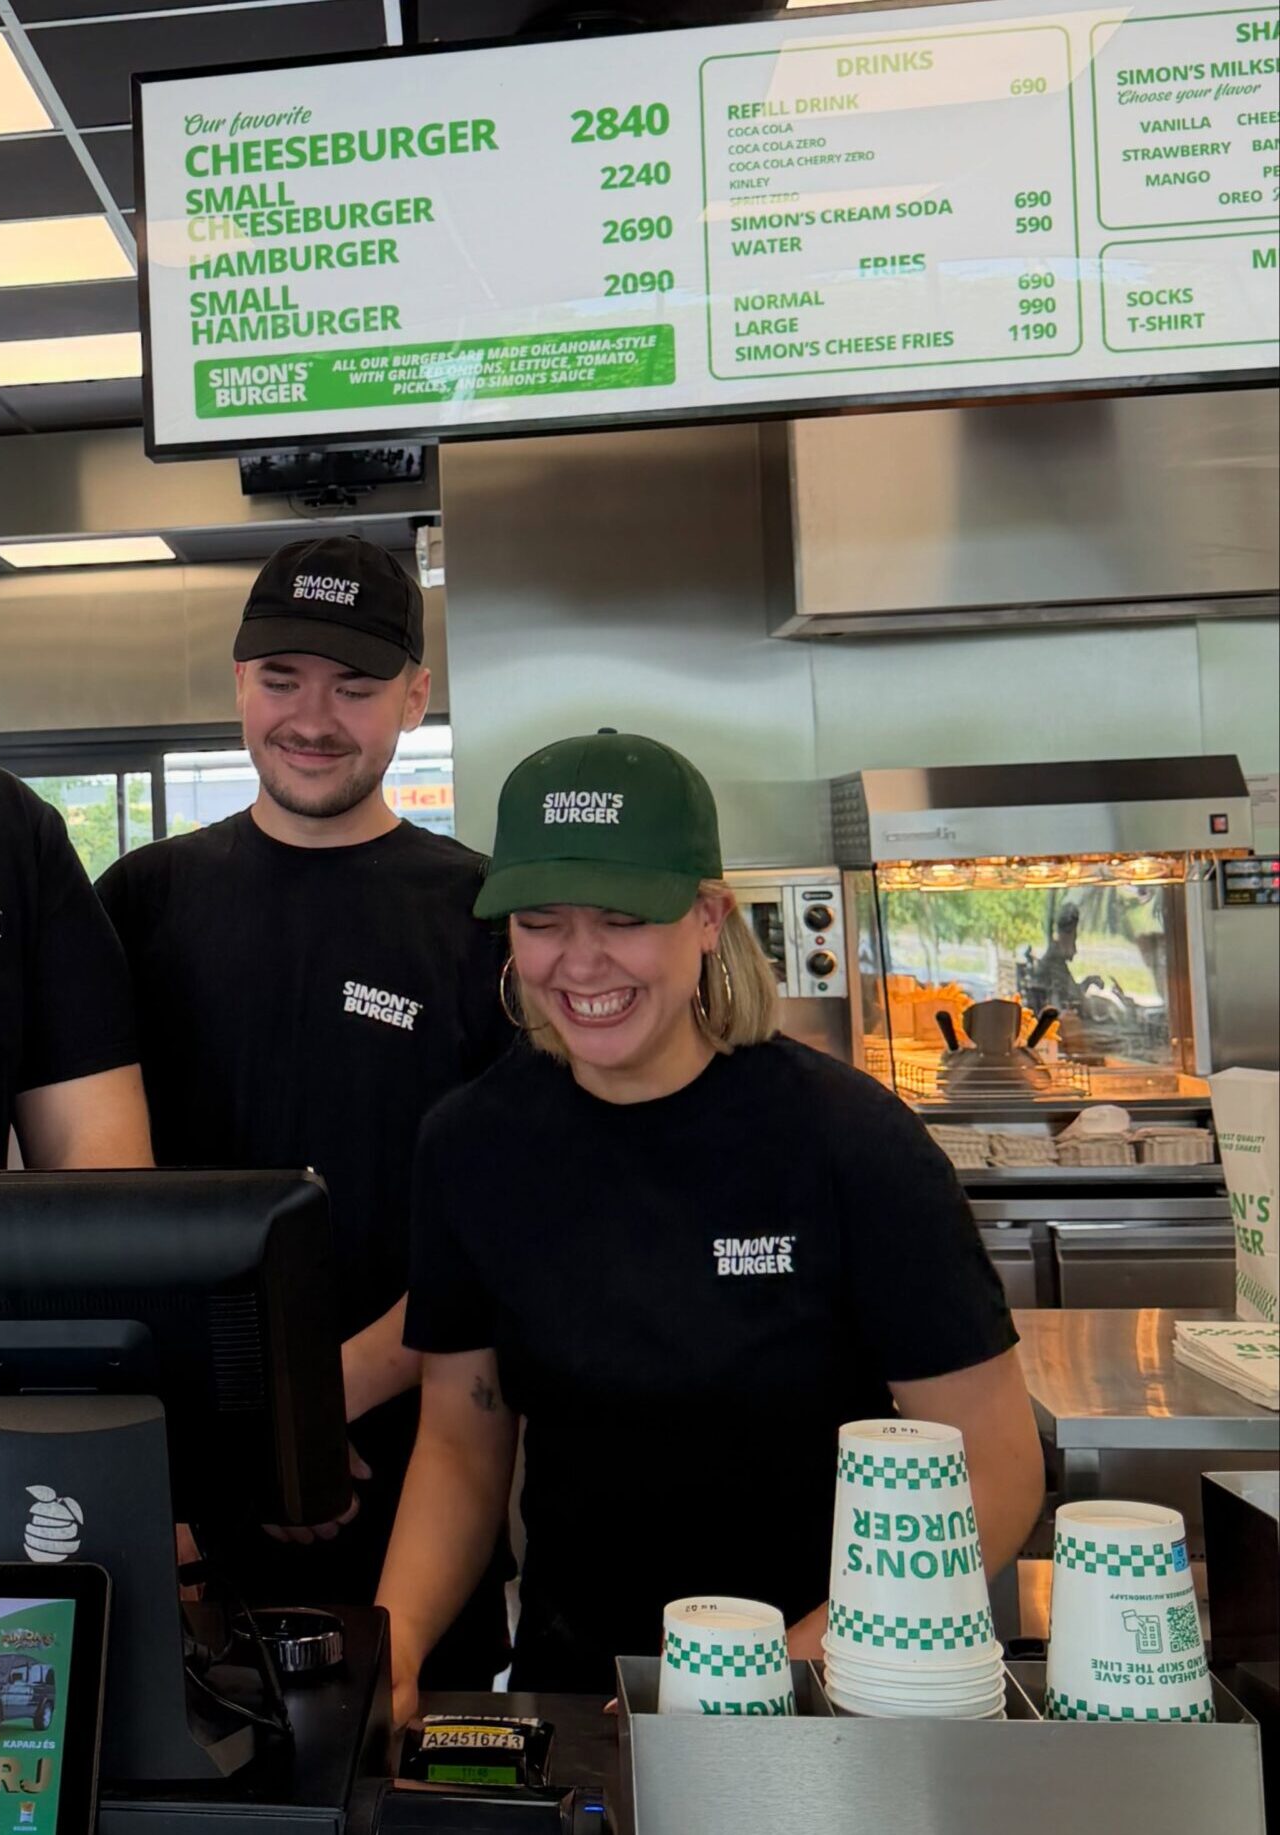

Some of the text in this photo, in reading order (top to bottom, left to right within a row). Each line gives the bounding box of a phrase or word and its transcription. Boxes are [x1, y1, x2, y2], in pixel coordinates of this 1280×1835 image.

[836, 50, 934, 78] DRINKS
[1116, 57, 1280, 86] SIMON'S MILKS
[1010, 77, 1046, 95] 690
[1117, 83, 1262, 105] Choose your flavor
[728, 94, 860, 120] REFILL DRINK
[184, 106, 312, 137] Our favorite
[571, 102, 670, 144] 2840
[1140, 116, 1212, 134] VANILLA
[1237, 110, 1280, 126] CHEE
[728, 123, 794, 138] COCA COLA
[185, 119, 499, 177] CHEESEBURGER
[728, 137, 827, 156] COCA COLA ZERO
[1122, 141, 1232, 162] STRAWBERRY
[729, 150, 875, 173] COCA COLA CHERRY ZERO
[601, 161, 671, 189] 2240
[729, 177, 770, 190] KINLEY
[1145, 170, 1210, 187] MANGO
[186, 182, 295, 215] SMALL
[1014, 190, 1051, 209] 690
[1218, 190, 1263, 205] OREO
[187, 197, 435, 242] CHEESEBURGER
[731, 199, 953, 232] SIMON'S CREAM SODA
[1015, 215, 1052, 234] 590
[602, 215, 673, 244] 2690
[732, 237, 802, 257] WATER
[189, 238, 400, 280] HAMBURGER
[859, 253, 926, 277] FRIES
[604, 269, 674, 297] 2090
[1018, 272, 1055, 290] 690
[190, 285, 299, 318] SMALL
[734, 290, 825, 312] NORMAL
[1019, 297, 1056, 315] 990
[1127, 288, 1194, 308] SOCKS
[191, 305, 402, 346] HAMBURGER
[735, 317, 799, 337] LARGE
[1008, 322, 1057, 341] 1190
[1127, 312, 1205, 333] T-SHIRT
[332, 359, 357, 372] ALL
[360, 357, 389, 370] OUR
[392, 351, 456, 367] BURGERS
[487, 345, 528, 360] MADE
[531, 335, 657, 357] OKLAHOMA-STYLE
[735, 331, 954, 362] SIMON'S CHEESE FRIES
[209, 362, 309, 388] SIMON'S
[349, 371, 384, 385] WITH
[510, 355, 571, 372] LETTUCE,
[393, 368, 596, 395] PICKLES, AND SIMON'S SAUCE
[216, 382, 307, 408] BURGER
[293, 574, 359, 594] SIMON'S
[293, 587, 355, 606] BURGER
[543, 791, 624, 808] SIMON'S
[544, 807, 620, 824] BURGER
[343, 981, 420, 1016] SIMON'S
[344, 996, 414, 1031] BURGER
[713, 1236, 793, 1257] SIMON'S
[717, 1254, 794, 1276] BURGER
[852, 1506, 976, 1543] BURGER
[1091, 1658, 1122, 1672] LINE
[1126, 1663, 1154, 1674] THE
[1157, 1661, 1184, 1673] SKIP
[1187, 1655, 1203, 1669] AND
[1095, 1671, 1131, 1684] SAVE
[1135, 1674, 1155, 1685] TO
[1159, 1671, 1197, 1685] AHEAD
[3, 1739, 56, 1749] KAPARJ ÉS
